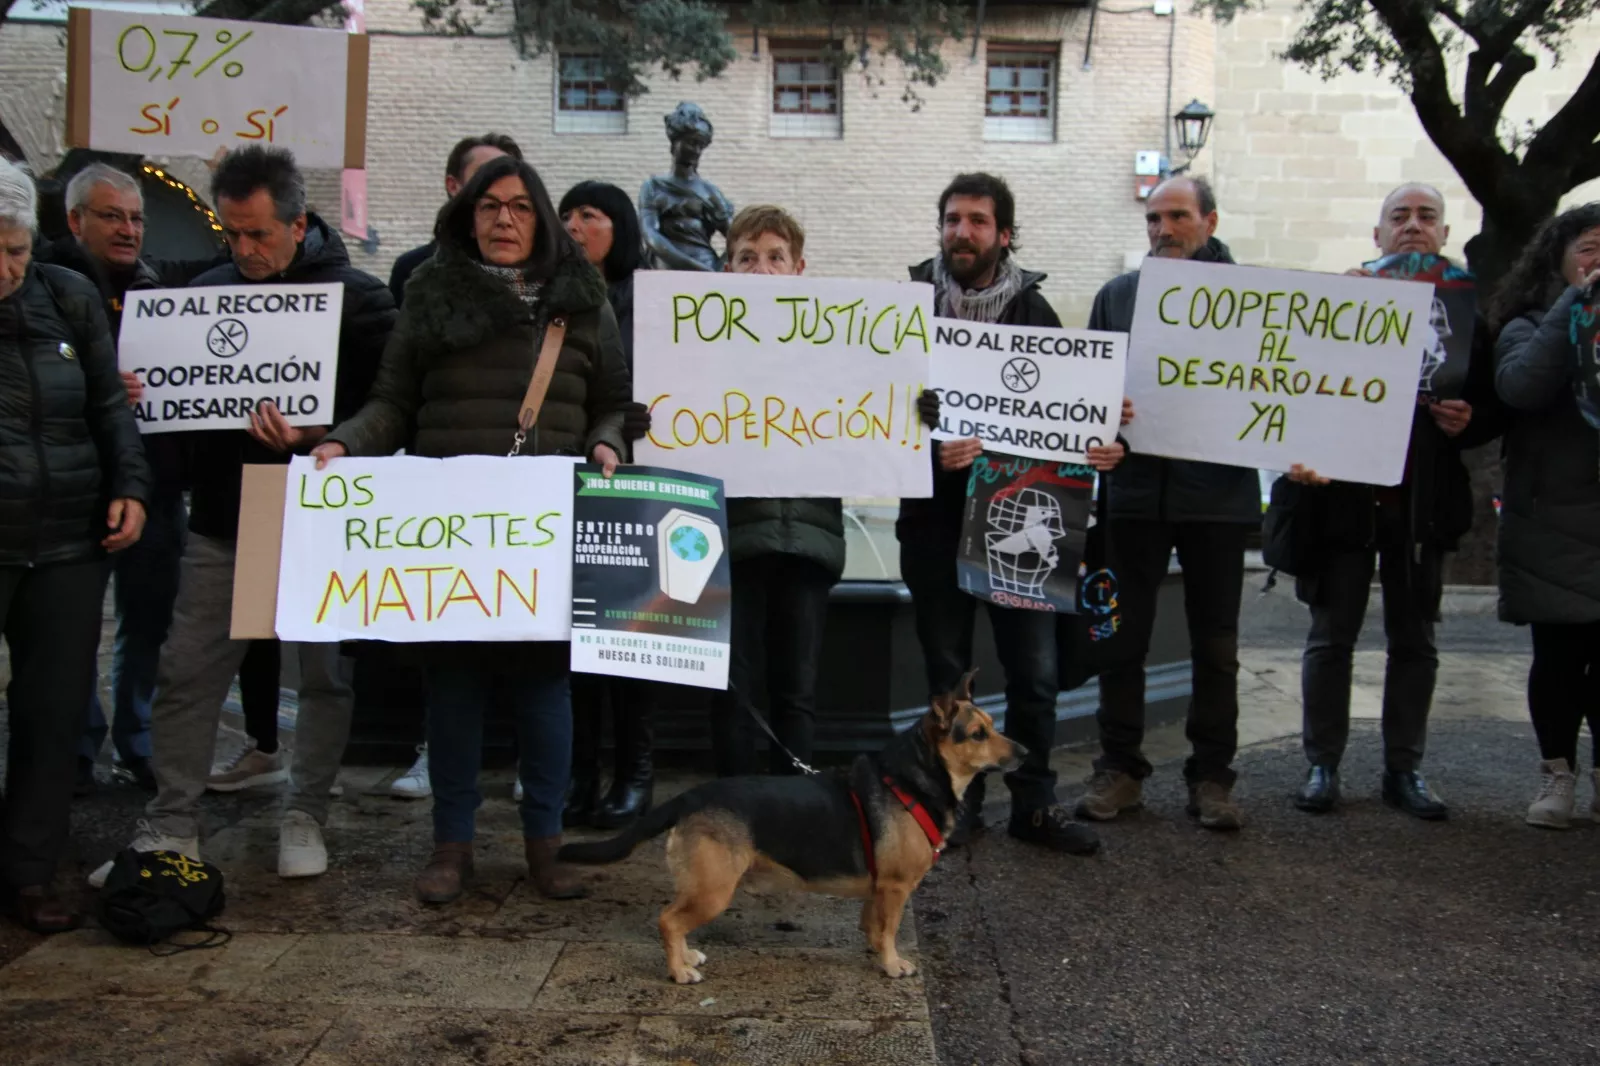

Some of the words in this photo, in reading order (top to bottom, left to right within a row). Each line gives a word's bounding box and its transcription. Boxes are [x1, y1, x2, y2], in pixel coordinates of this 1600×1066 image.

[117, 23, 254, 82] 0,7%
[136, 298, 175, 318] NO
[179, 296, 210, 316] AL
[217, 293, 328, 315] RECORTE
[673, 292, 760, 344] POR
[1158, 285, 1413, 347] COOPERACIÓN
[935, 325, 972, 347] NO
[976, 331, 1004, 351] AL
[1010, 334, 1114, 360] RECORTE
[1258, 331, 1297, 363] AL
[1156, 356, 1387, 404] DESARROLLO
[134, 401, 158, 422] AL
[1238, 400, 1286, 443] YA
[959, 419, 1103, 455] DESARROLLO
[301, 474, 374, 508] LOS
[613, 478, 656, 492] QUIEREN
[346, 512, 562, 551] RECORTES
[576, 520, 654, 536] ENTIERRO
[576, 533, 600, 543] POR
[607, 535, 622, 544] LA
[575, 543, 641, 556] COOPERACIÓN
[575, 554, 650, 567] INTERNACIONAL
[315, 567, 538, 627] MATAN
[604, 609, 670, 623] AYUNTAMIENTO
[672, 615, 684, 625] DE
[686, 617, 718, 629] HUESCA
[579, 635, 591, 644] NO
[595, 636, 606, 645] AL
[610, 637, 648, 649] RECORTE
[651, 640, 662, 650] EN
[665, 641, 723, 658] COOPERACIÓN
[598, 649, 636, 663] HUESCA
[640, 653, 652, 665] ES
[656, 655, 705, 672] SOLIDARIA
